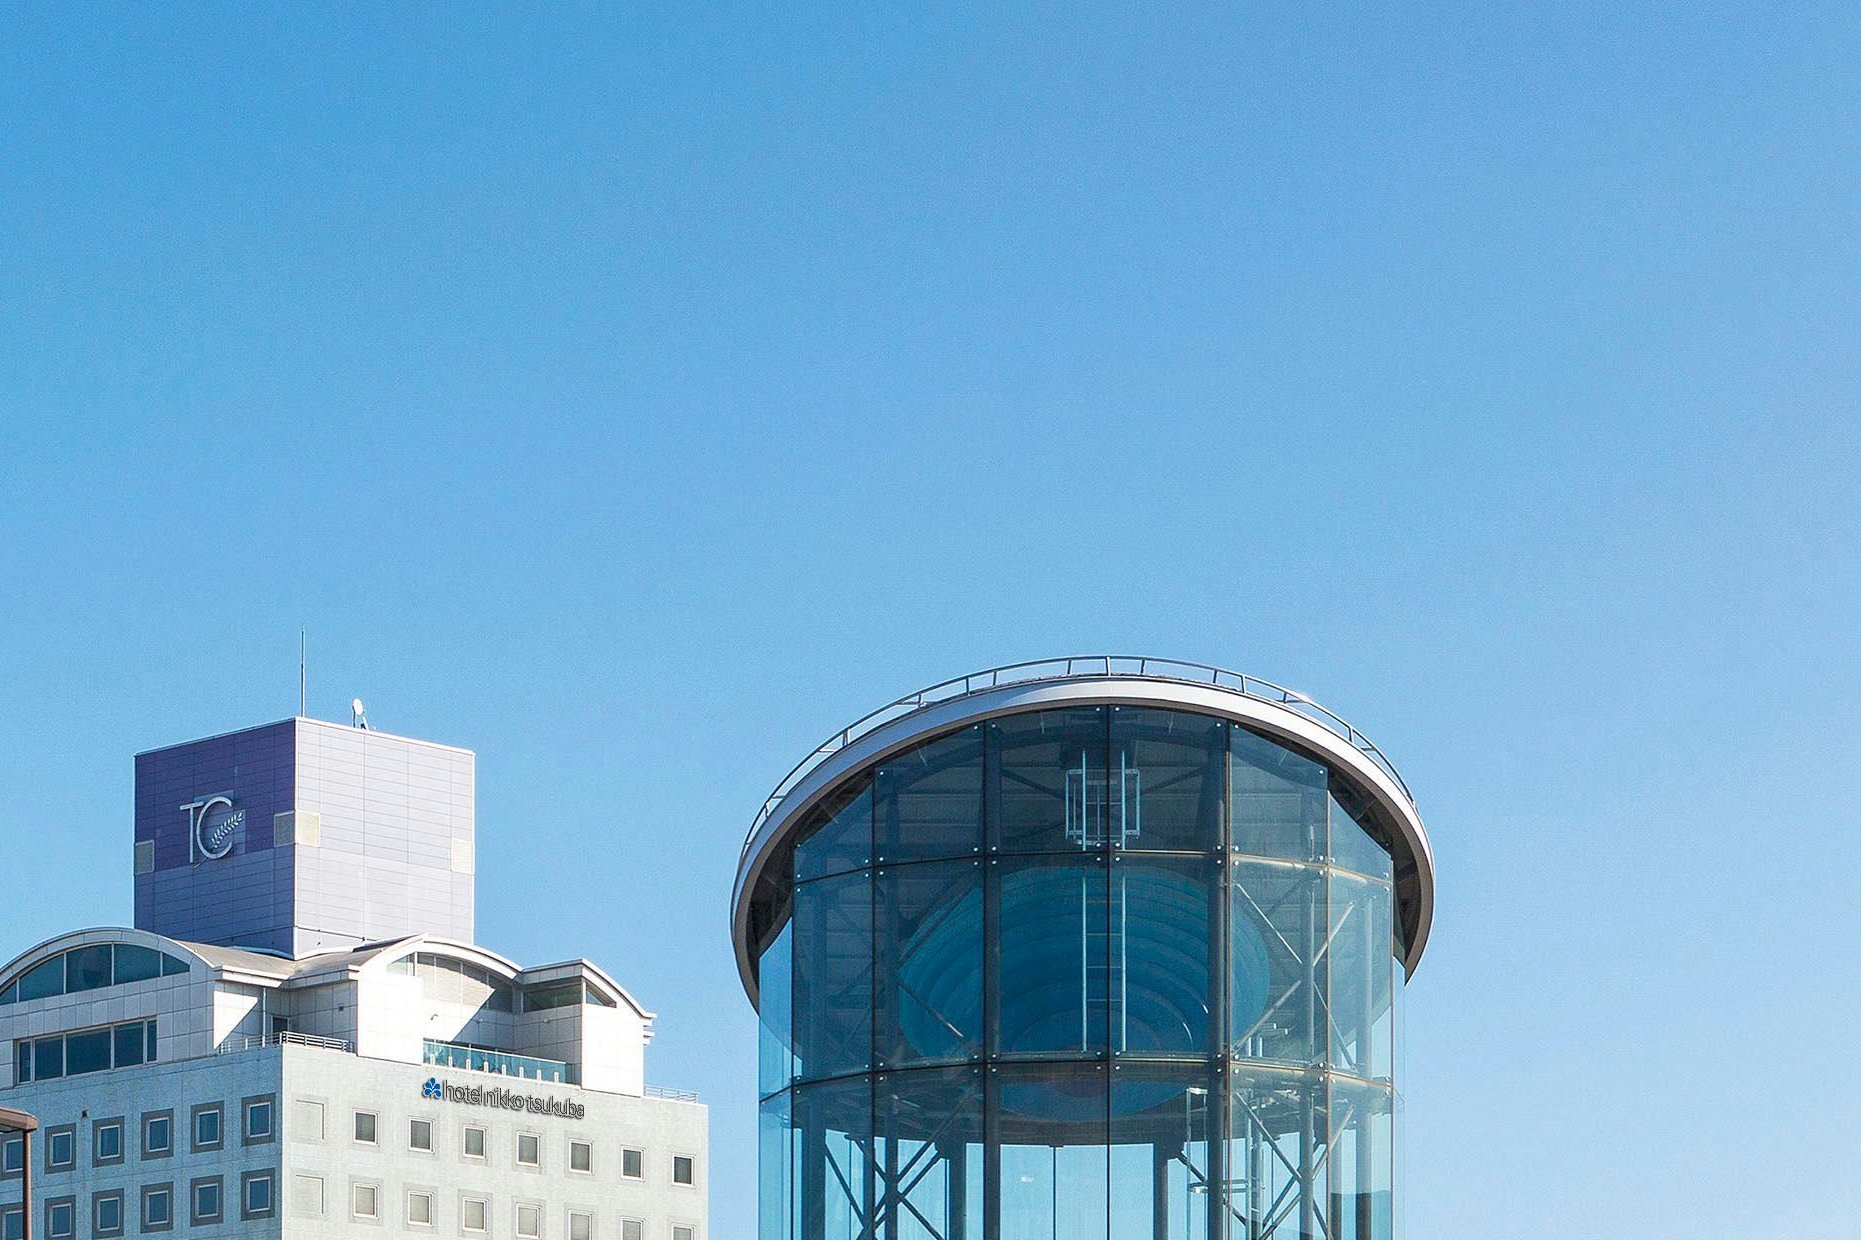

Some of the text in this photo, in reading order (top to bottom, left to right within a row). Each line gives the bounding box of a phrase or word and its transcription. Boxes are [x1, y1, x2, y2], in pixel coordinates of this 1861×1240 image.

[441, 1080, 585, 1119] hotel nikko tsukuba
